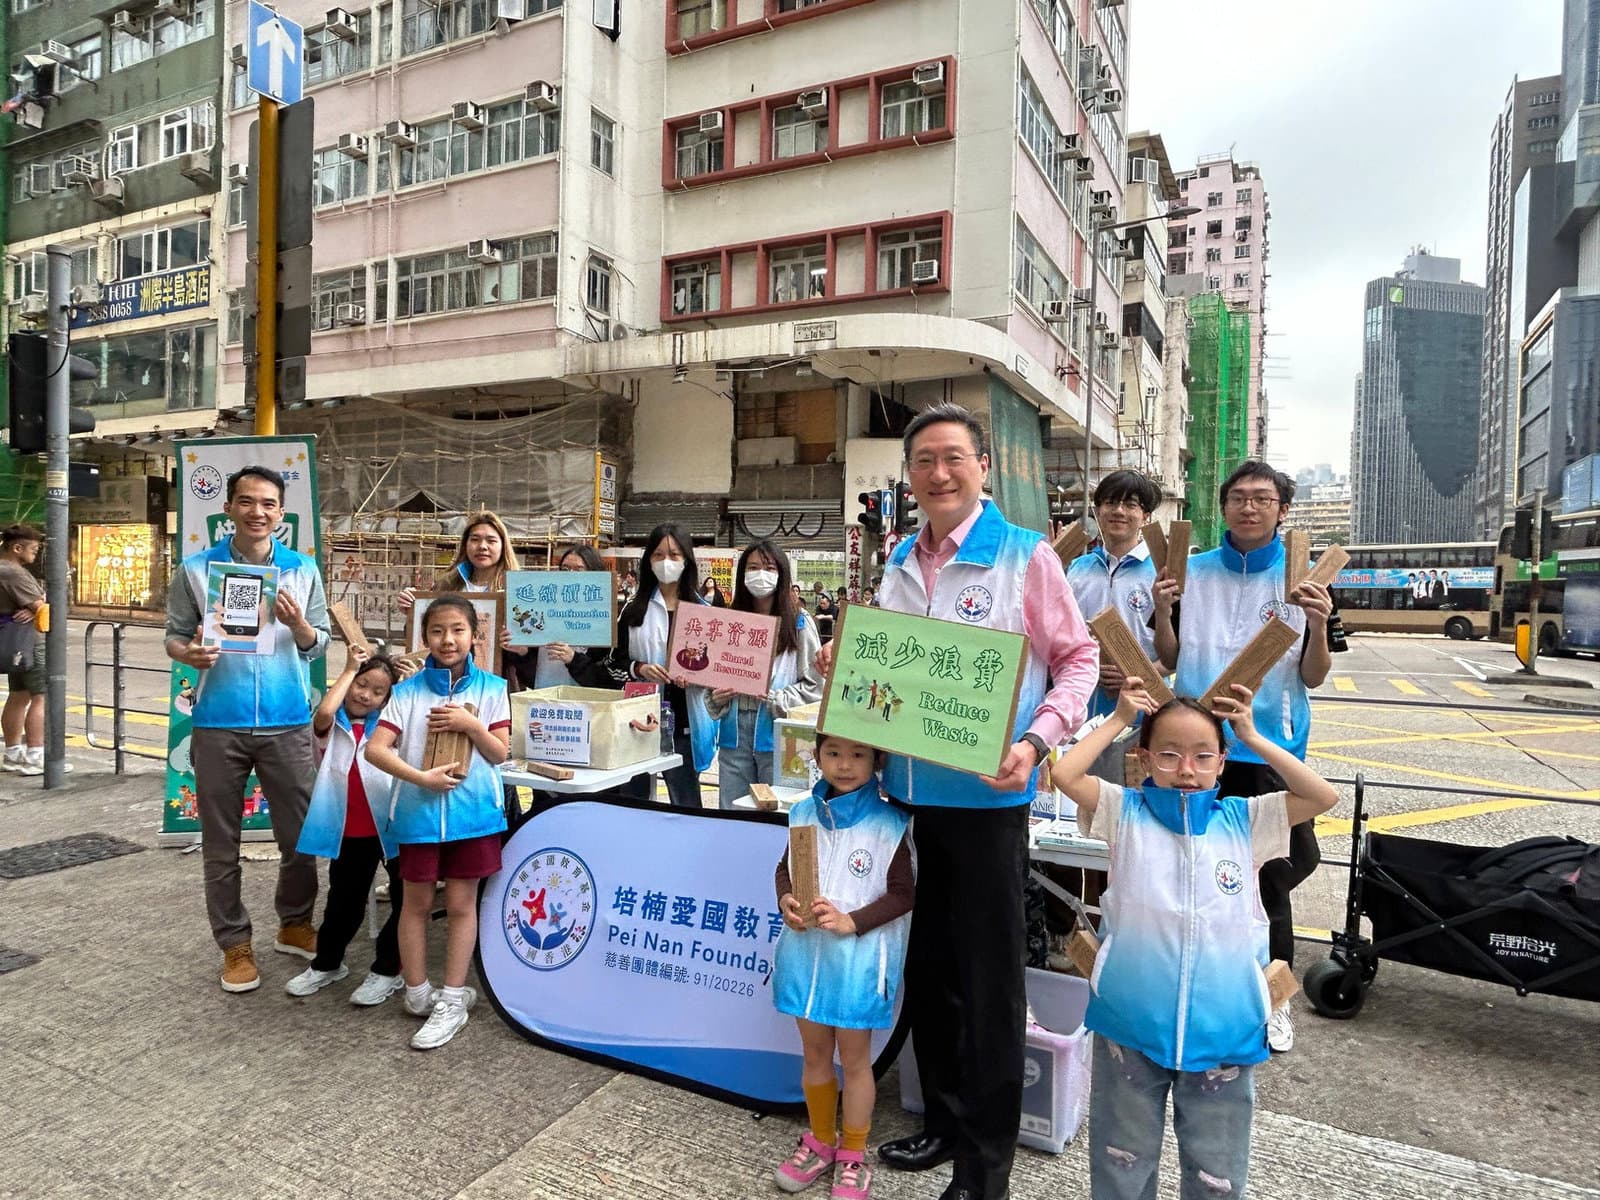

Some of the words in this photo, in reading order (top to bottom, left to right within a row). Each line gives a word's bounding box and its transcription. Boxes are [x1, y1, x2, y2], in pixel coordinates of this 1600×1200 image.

[110, 301, 132, 318] 0058
[684, 617, 769, 649] 共享資源
[855, 632, 1004, 693] 減少浪費
[919, 691, 990, 723] Reduce
[923, 718, 978, 746] Waste
[608, 924, 638, 948] Pei
[643, 931, 683, 956] Nan
[1519, 951, 1550, 963] NATURE
[604, 952, 690, 984] 慈善團體編號:
[693, 971, 755, 998] 91/20226
